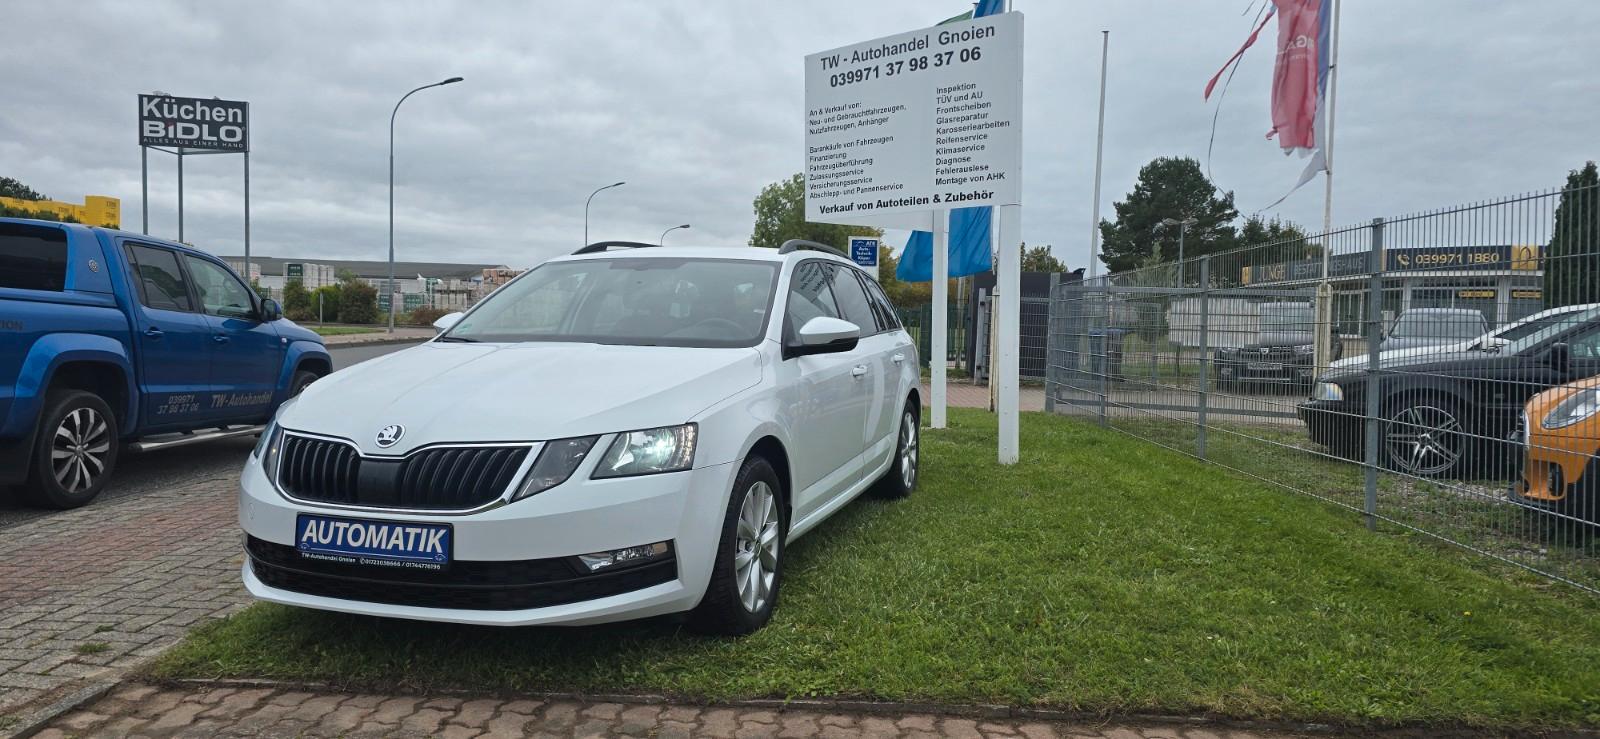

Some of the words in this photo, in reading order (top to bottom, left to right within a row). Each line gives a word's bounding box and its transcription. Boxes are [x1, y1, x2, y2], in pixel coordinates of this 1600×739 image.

[820, 54, 841, 71] TW
[851, 35, 929, 64] Autohandel
[938, 25, 996, 46] Gnoien
[830, 65, 880, 88] 039971
[885, 61, 904, 77] 37
[909, 55, 928, 72] 98
[934, 51, 954, 67] 37
[959, 46, 982, 63] 06
[936, 83, 976, 94] Inspektion
[936, 95, 952, 105] TÜV
[954, 93, 969, 102] und
[971, 91, 983, 100] AU
[142, 96, 243, 123] Küchen
[824, 104, 847, 114] Verkauf
[936, 102, 992, 115] Frontscheiben
[809, 118, 823, 126] Neu-
[824, 116, 835, 124] und
[857, 116, 889, 127] Anhänger
[936, 112, 989, 125] Glasreparatur
[936, 120, 1010, 135] Karosseriearbeiten
[843, 139, 855, 147] von
[856, 135, 894, 147] Fahrzeugen
[936, 133, 988, 145] Reifenservice
[935, 144, 985, 155] Klimaservice
[809, 152, 847, 163] Finanzierung
[935, 156, 971, 166] Diagnose
[809, 168, 864, 181] Zulassungsservice
[935, 165, 989, 176] Fehlerauslese
[809, 177, 873, 190] Versicherungsservice
[935, 176, 968, 186] Montage
[970, 175, 985, 183] von
[986, 172, 1006, 181] AHK
[843, 187, 855, 196] und
[856, 182, 904, 193] Pannenservice
[819, 202, 854, 214] Verkauf
[857, 201, 873, 211] von
[876, 196, 929, 209] Autoteilen
[933, 194, 941, 203] &
[944, 190, 995, 202] Zubehör
[1415, 253, 1463, 264] 039971
[1468, 252, 1500, 263] 1880
[301, 519, 448, 554] AUTOMATIK
